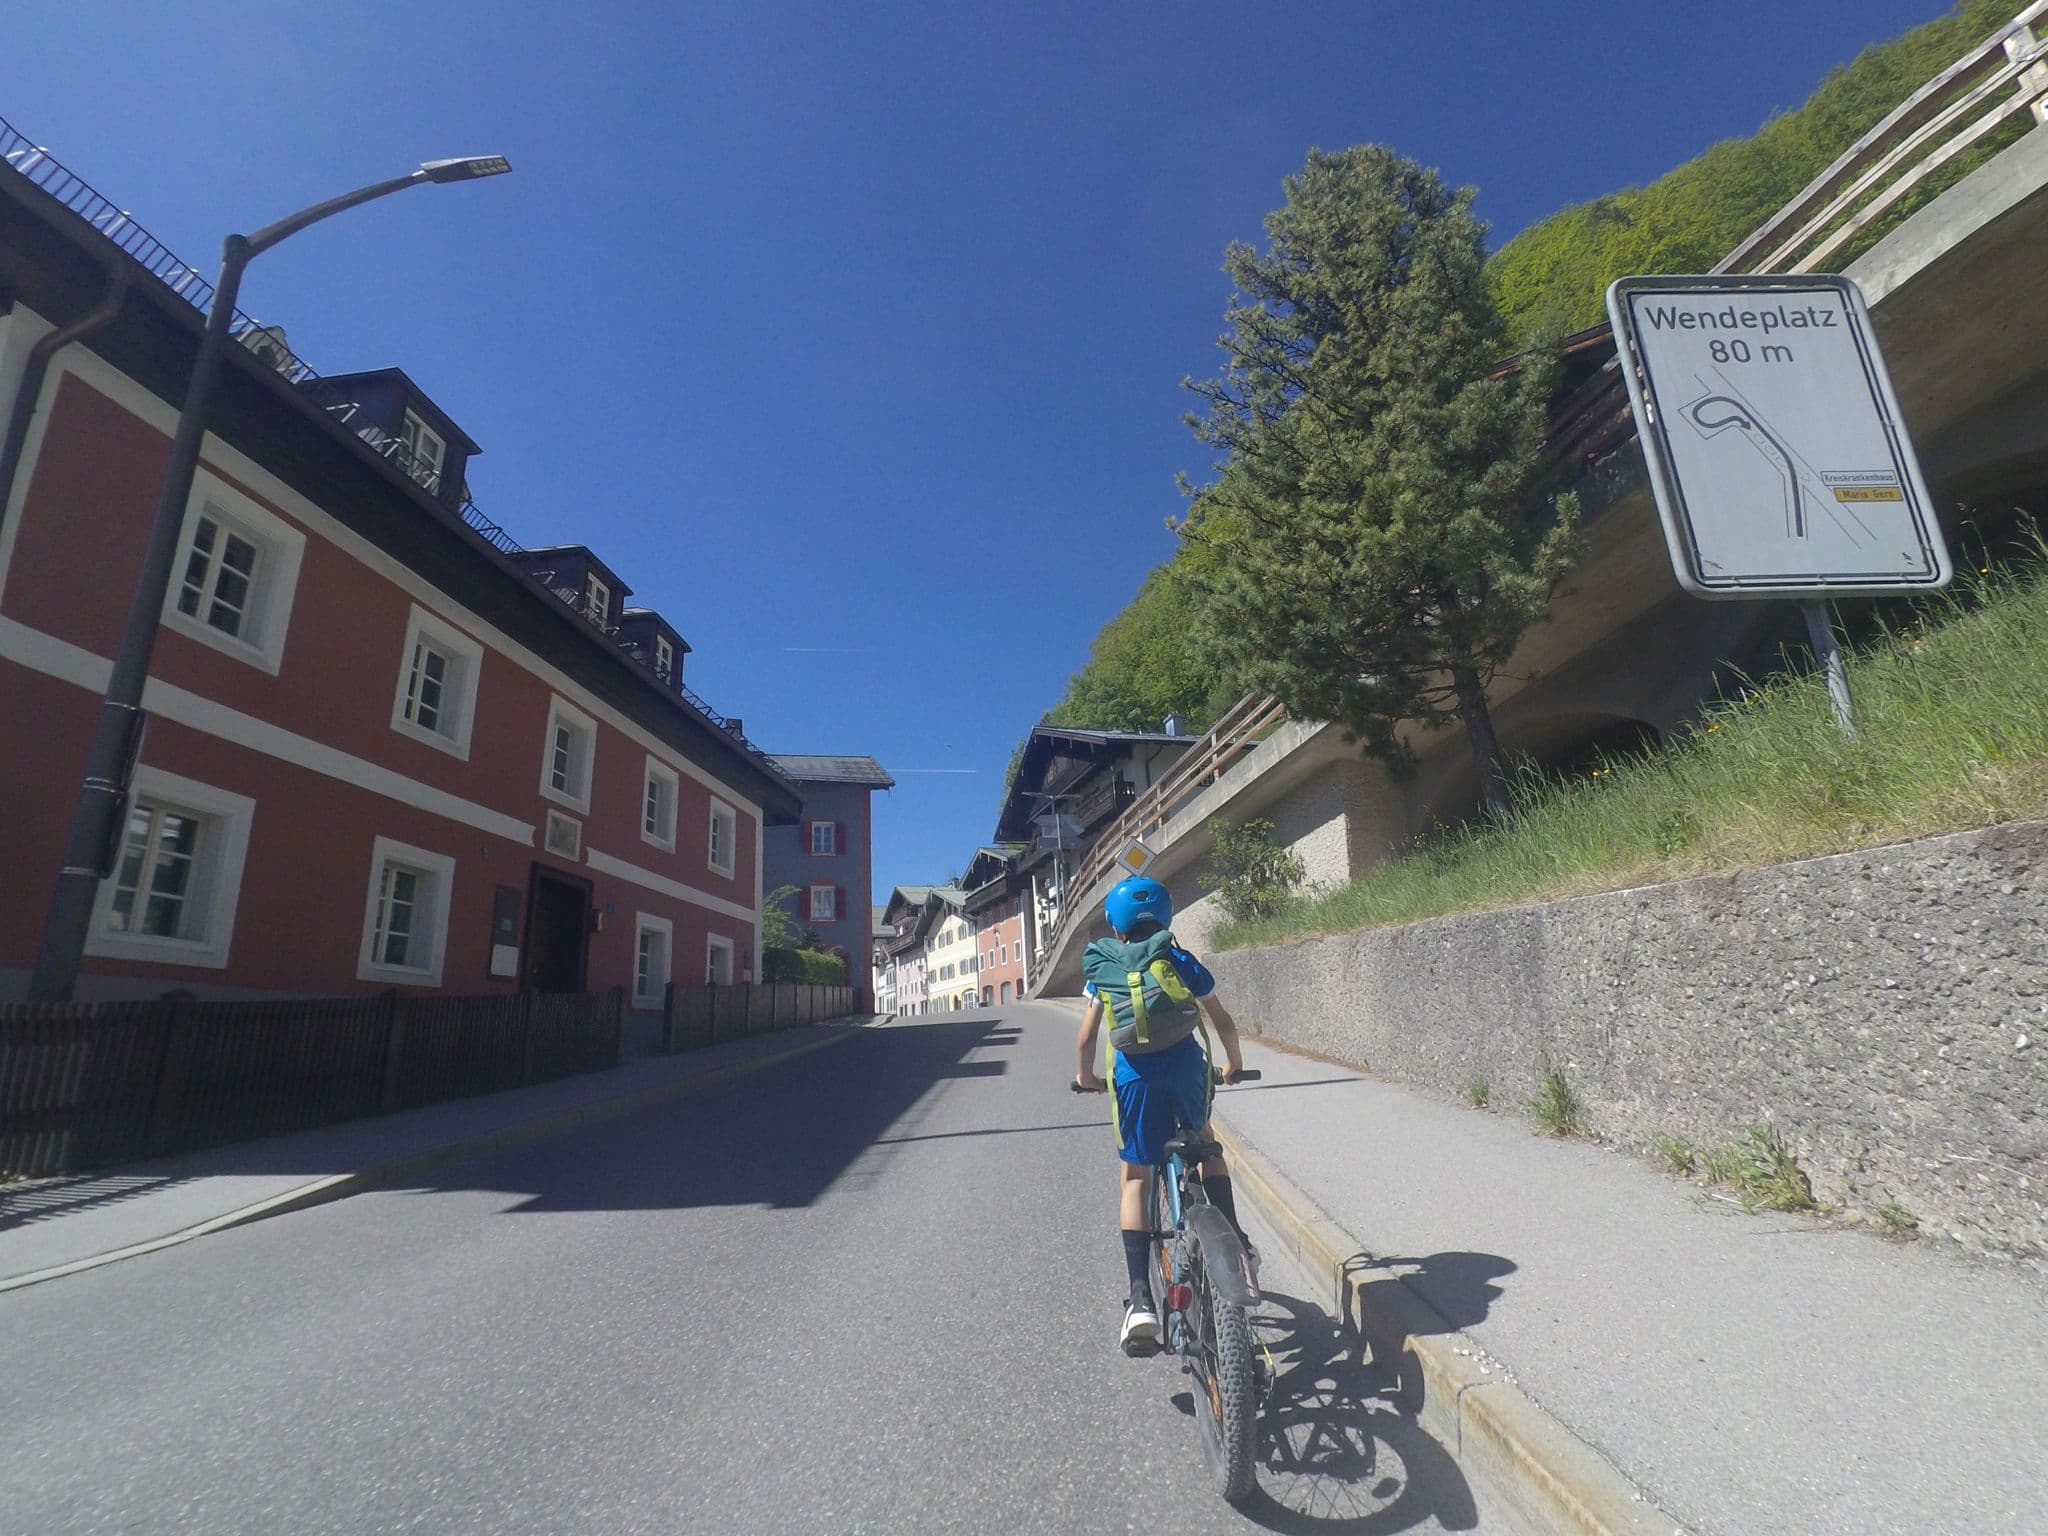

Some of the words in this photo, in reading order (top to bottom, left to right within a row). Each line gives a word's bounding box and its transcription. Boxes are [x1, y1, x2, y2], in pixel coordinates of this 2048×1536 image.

[1645, 305, 1838, 334] Wendeplatz
[1709, 339, 1752, 364] 80
[1761, 343, 1794, 364] m
